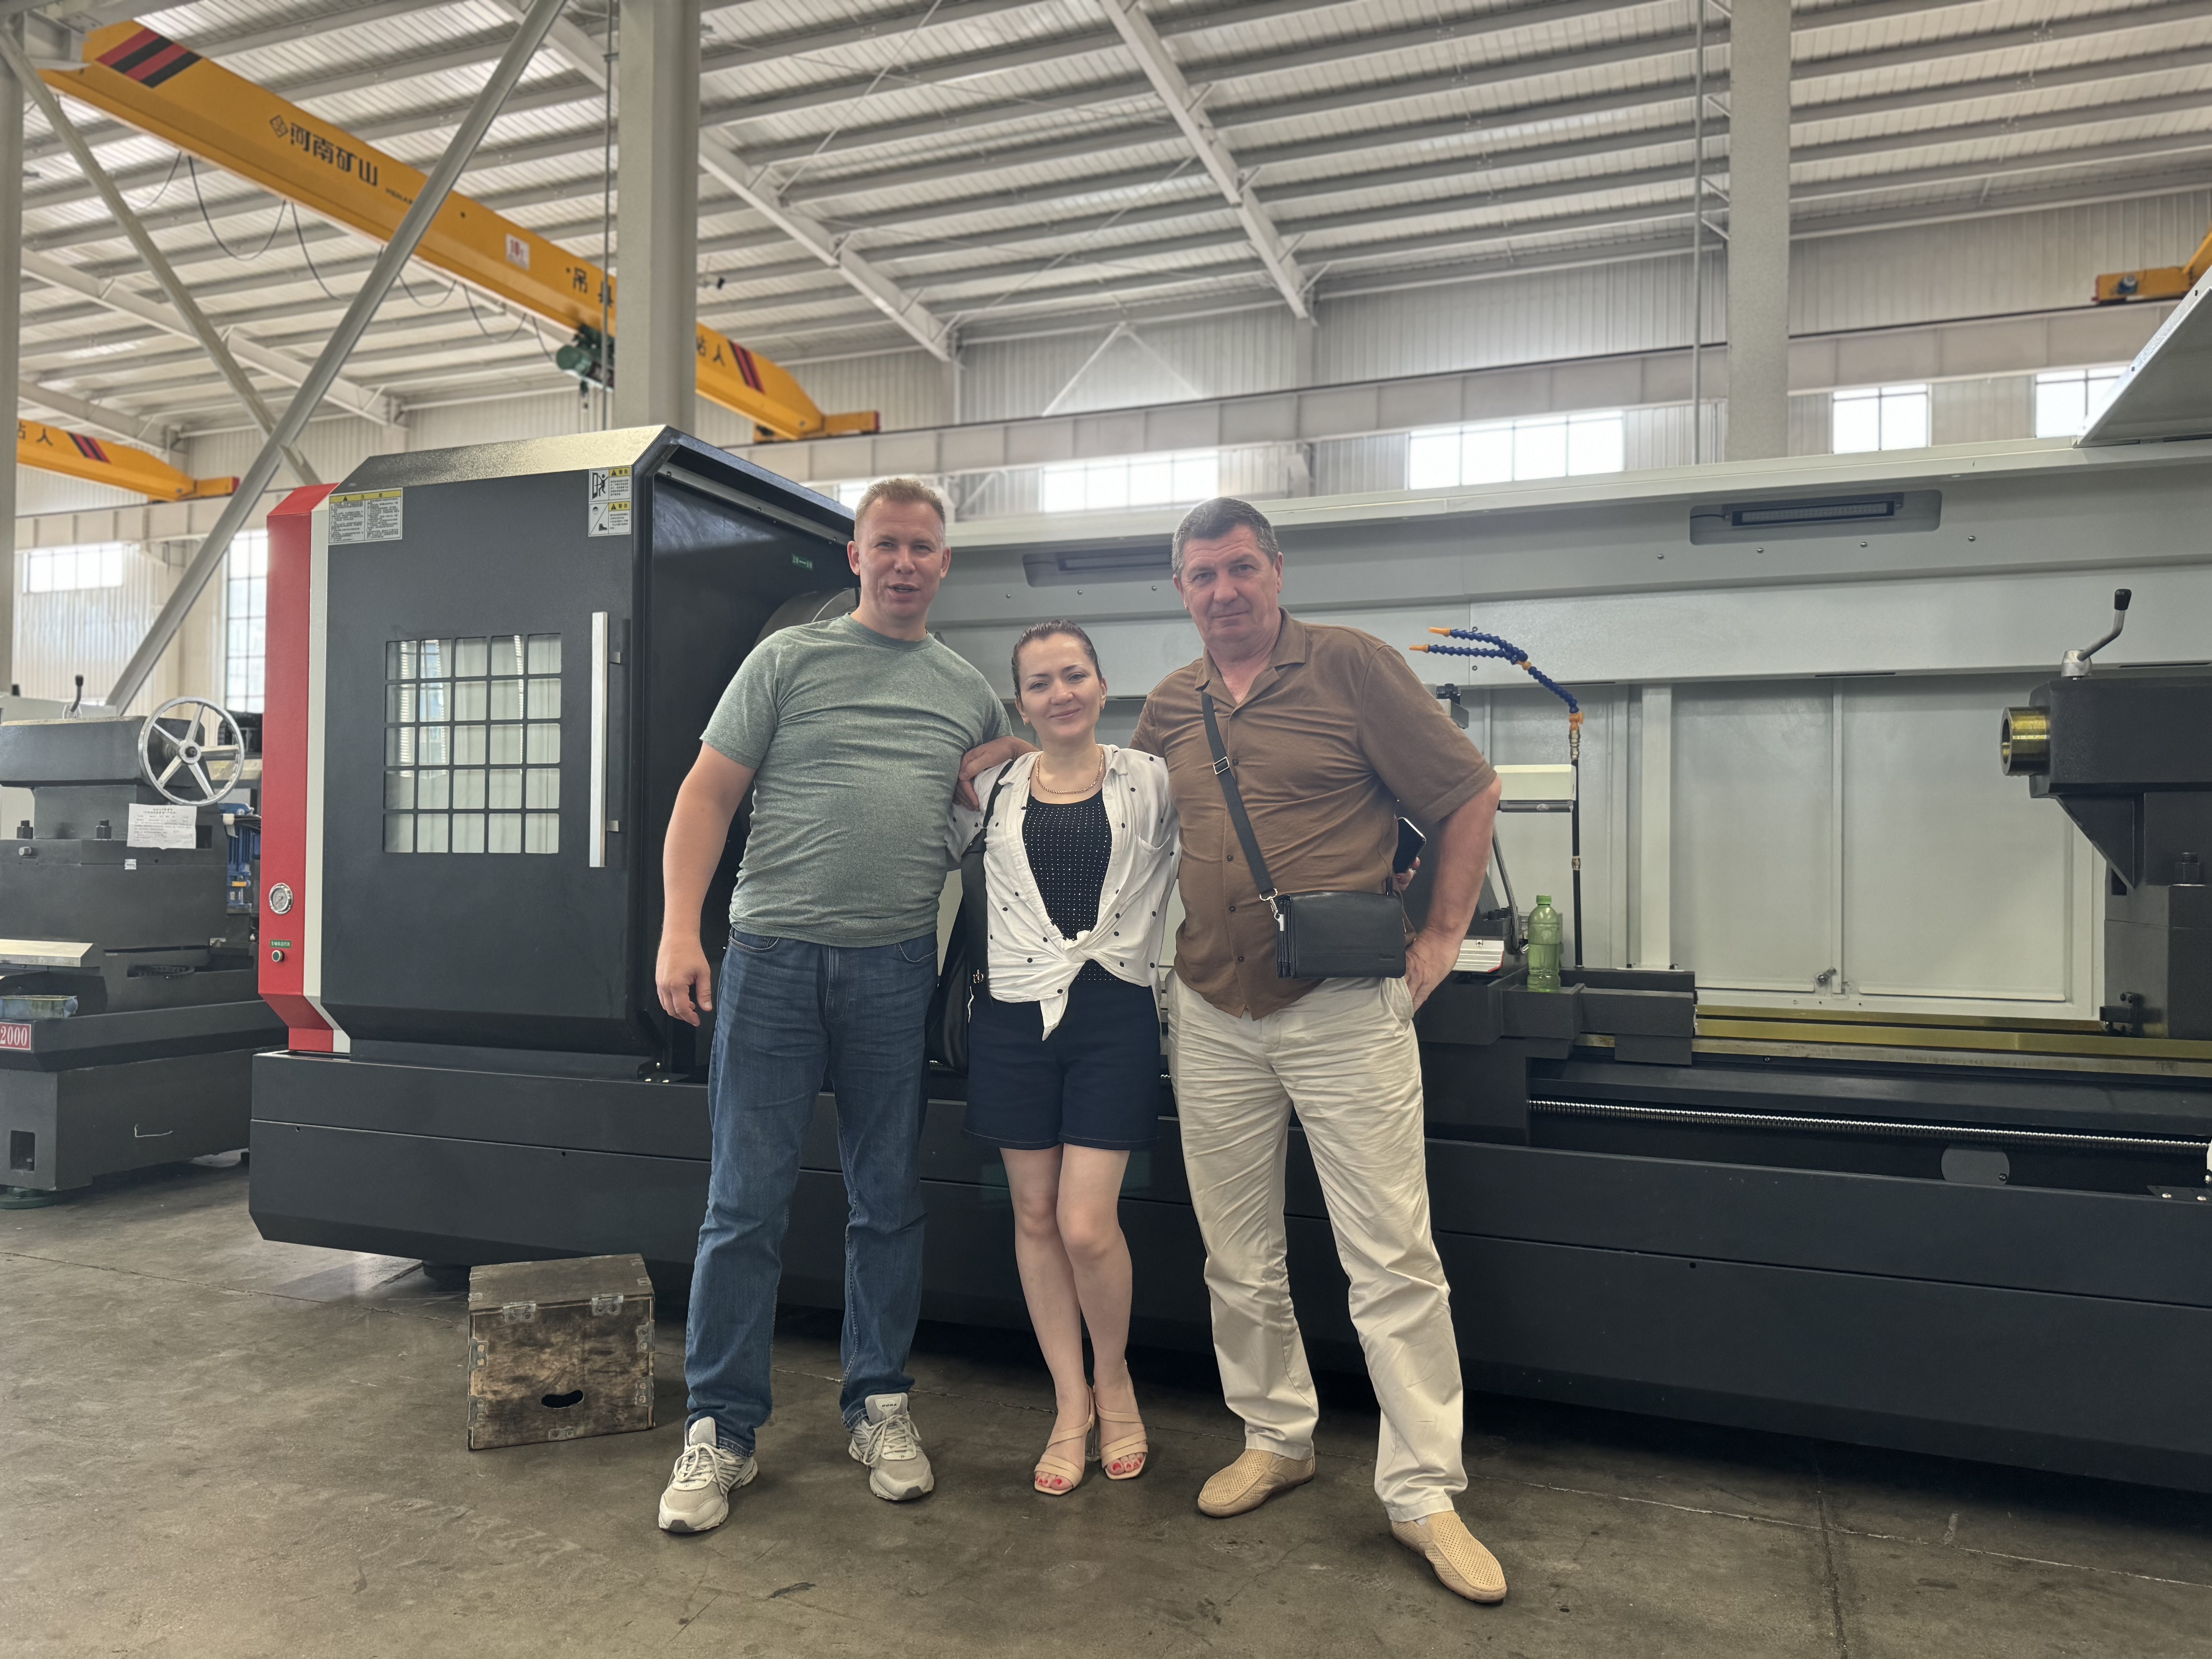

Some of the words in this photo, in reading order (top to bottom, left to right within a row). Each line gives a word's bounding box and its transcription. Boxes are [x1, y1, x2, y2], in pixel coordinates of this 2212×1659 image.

[291, 122, 378, 187] 河南矿山
[0, 1026, 27, 1046] 2000
